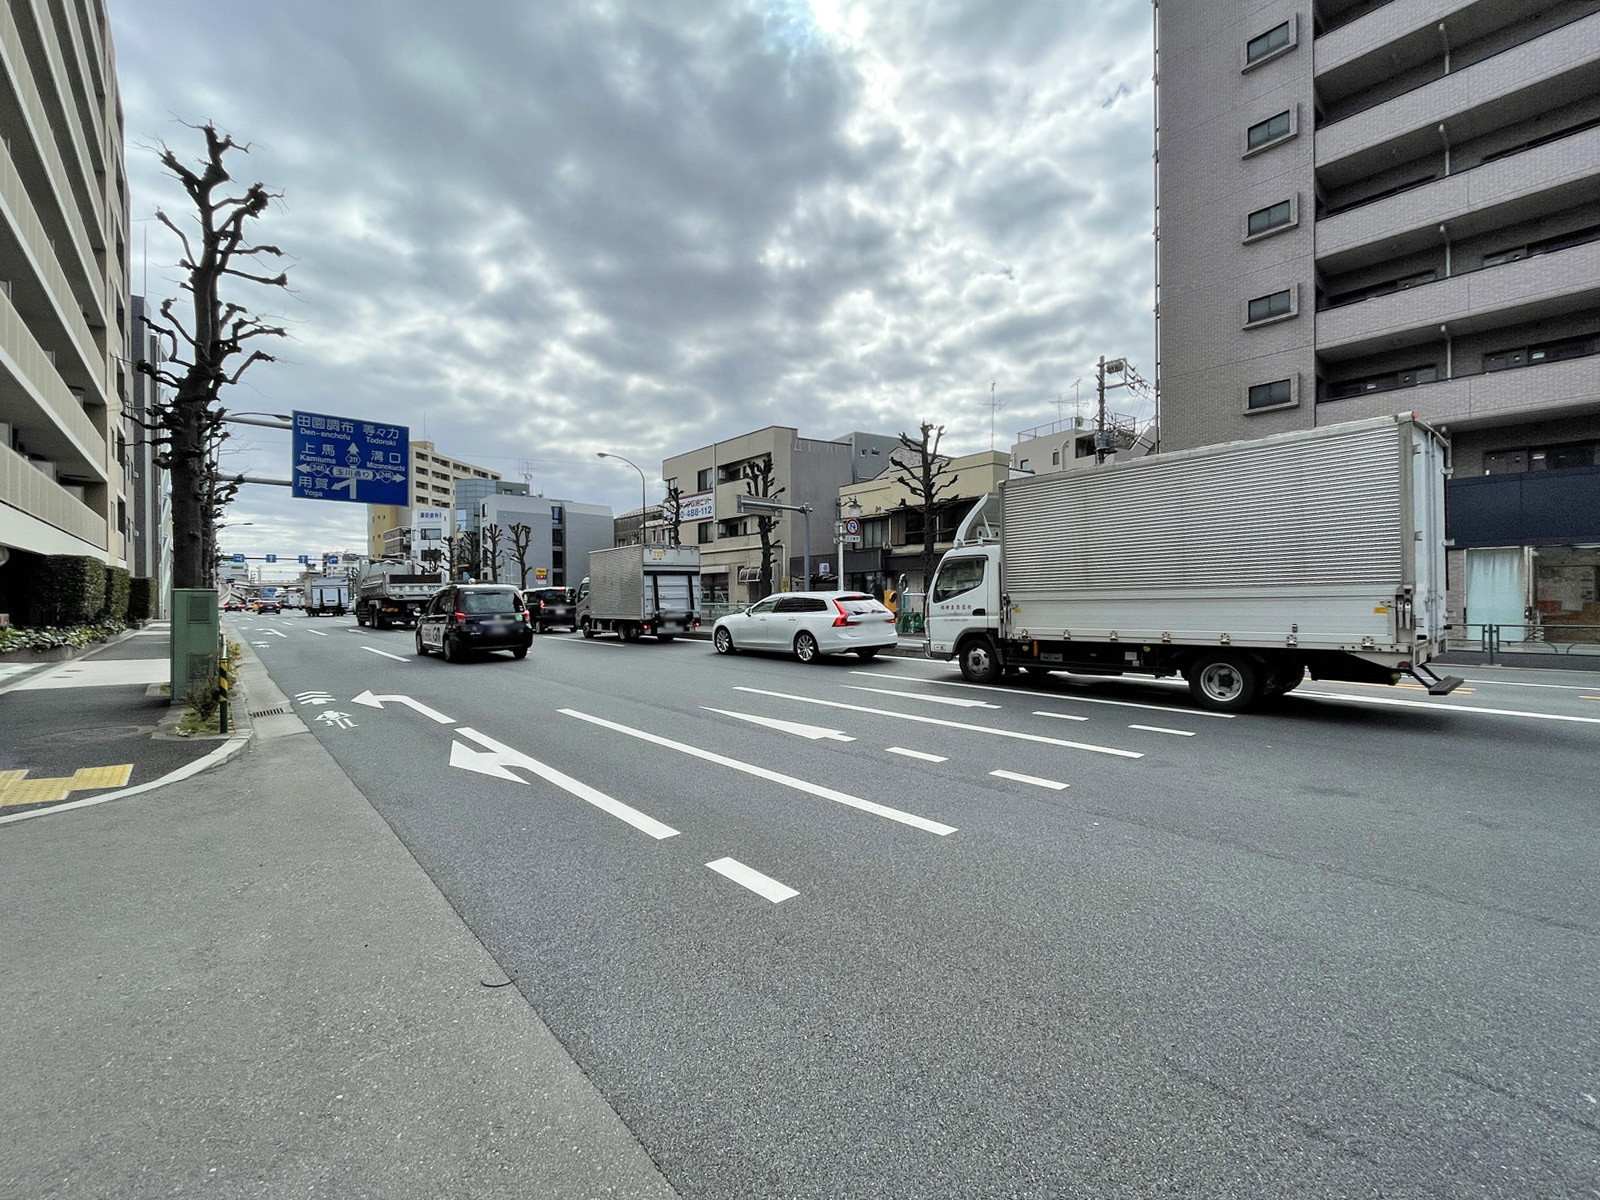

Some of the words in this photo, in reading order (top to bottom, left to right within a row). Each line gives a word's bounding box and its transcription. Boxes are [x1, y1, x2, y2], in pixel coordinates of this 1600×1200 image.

[297, 415, 354, 433] 田園調布
[363, 424, 399, 439] 等々力
[300, 428, 350, 440] Den-enchofu
[366, 437, 396, 446] Todoroki
[300, 454, 336, 464] Kamiuma
[366, 462, 405, 471] Mizonokuchi
[298, 476, 329, 490] 用賀
[303, 489, 323, 497] Yoga
